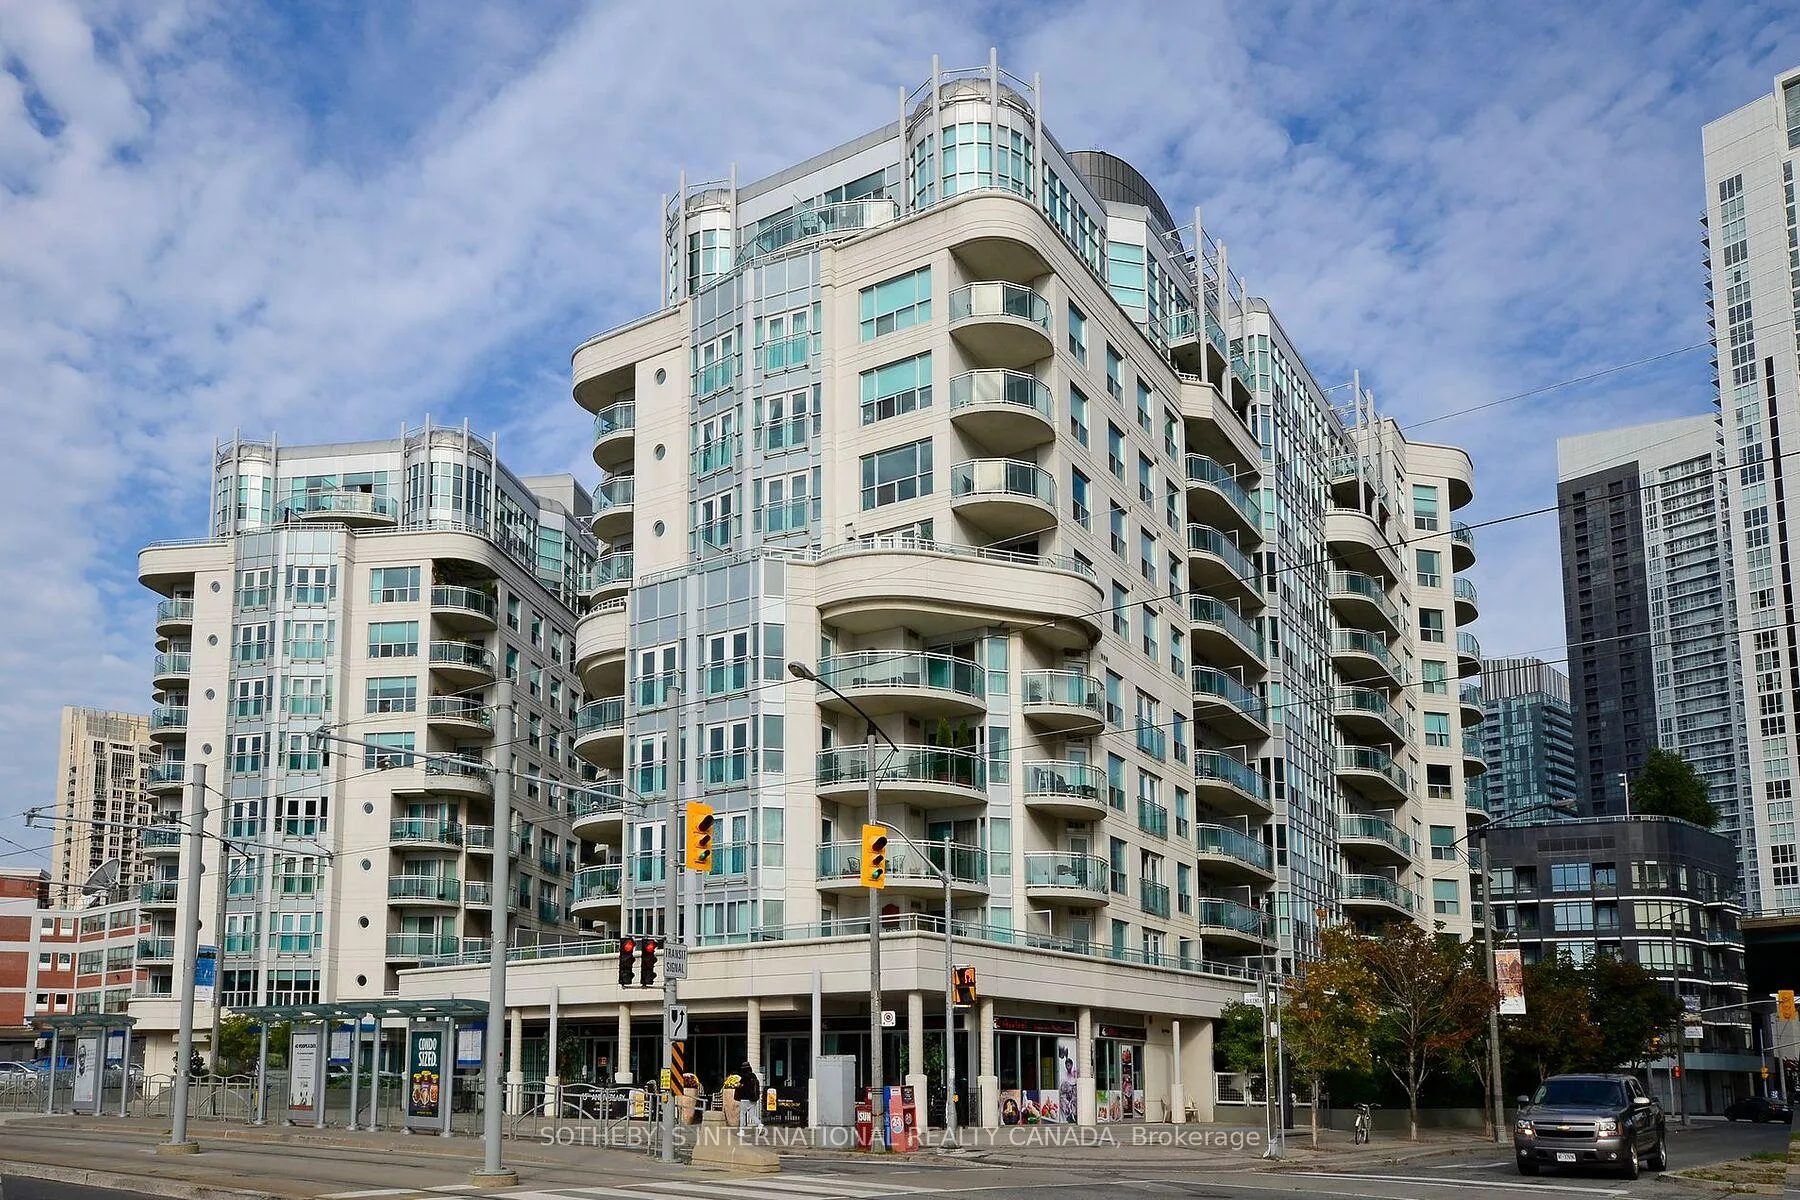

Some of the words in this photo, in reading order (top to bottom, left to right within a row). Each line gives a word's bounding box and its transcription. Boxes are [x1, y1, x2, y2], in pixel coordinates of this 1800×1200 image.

[665, 948, 686, 960] TRANSIT
[666, 962, 684, 974] SIGNAL
[418, 1037, 437, 1050] CONDO
